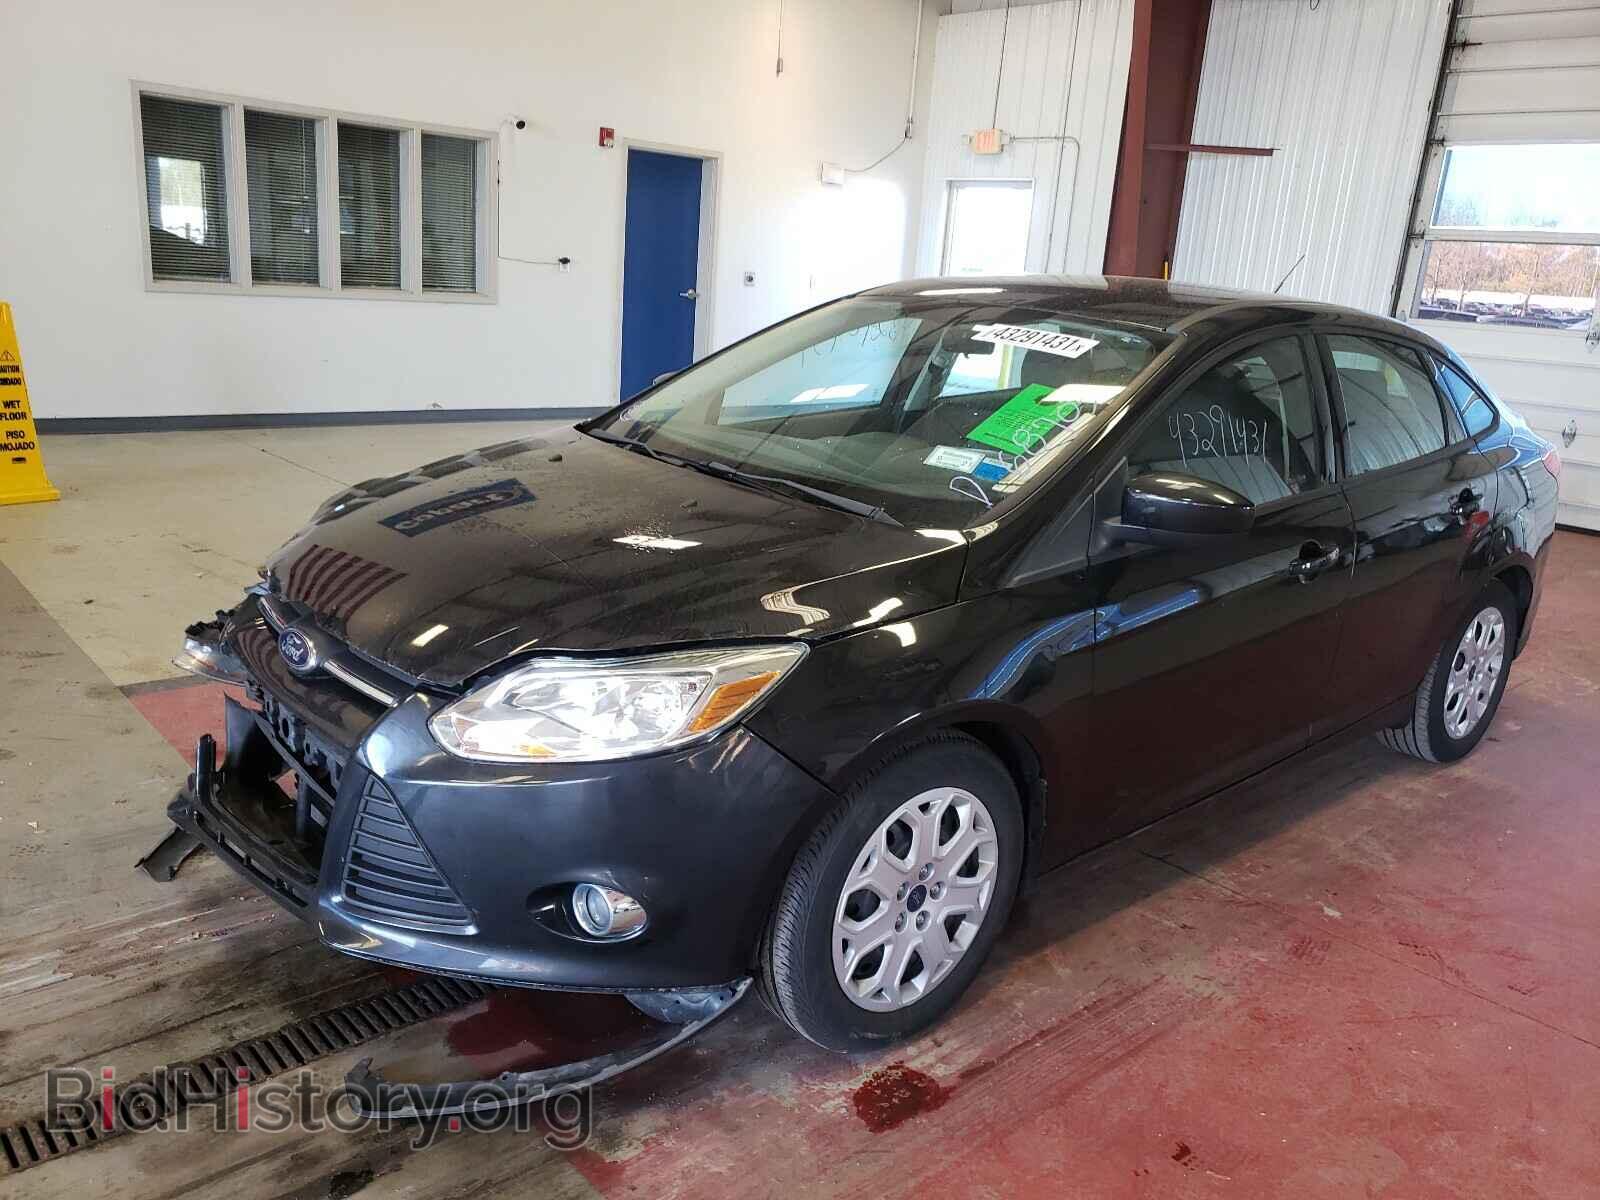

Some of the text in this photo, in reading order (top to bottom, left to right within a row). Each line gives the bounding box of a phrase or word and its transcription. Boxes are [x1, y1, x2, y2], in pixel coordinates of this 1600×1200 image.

[991, 325, 1079, 351] 43291431
[3, 401, 21, 409] WET
[0, 412, 27, 421] FLOOR
[6, 431, 25, 440] PISO
[1168, 404, 1268, 468] 43291431
[0, 442, 35, 452] MOJADO
[281, 633, 305, 662] Ford
